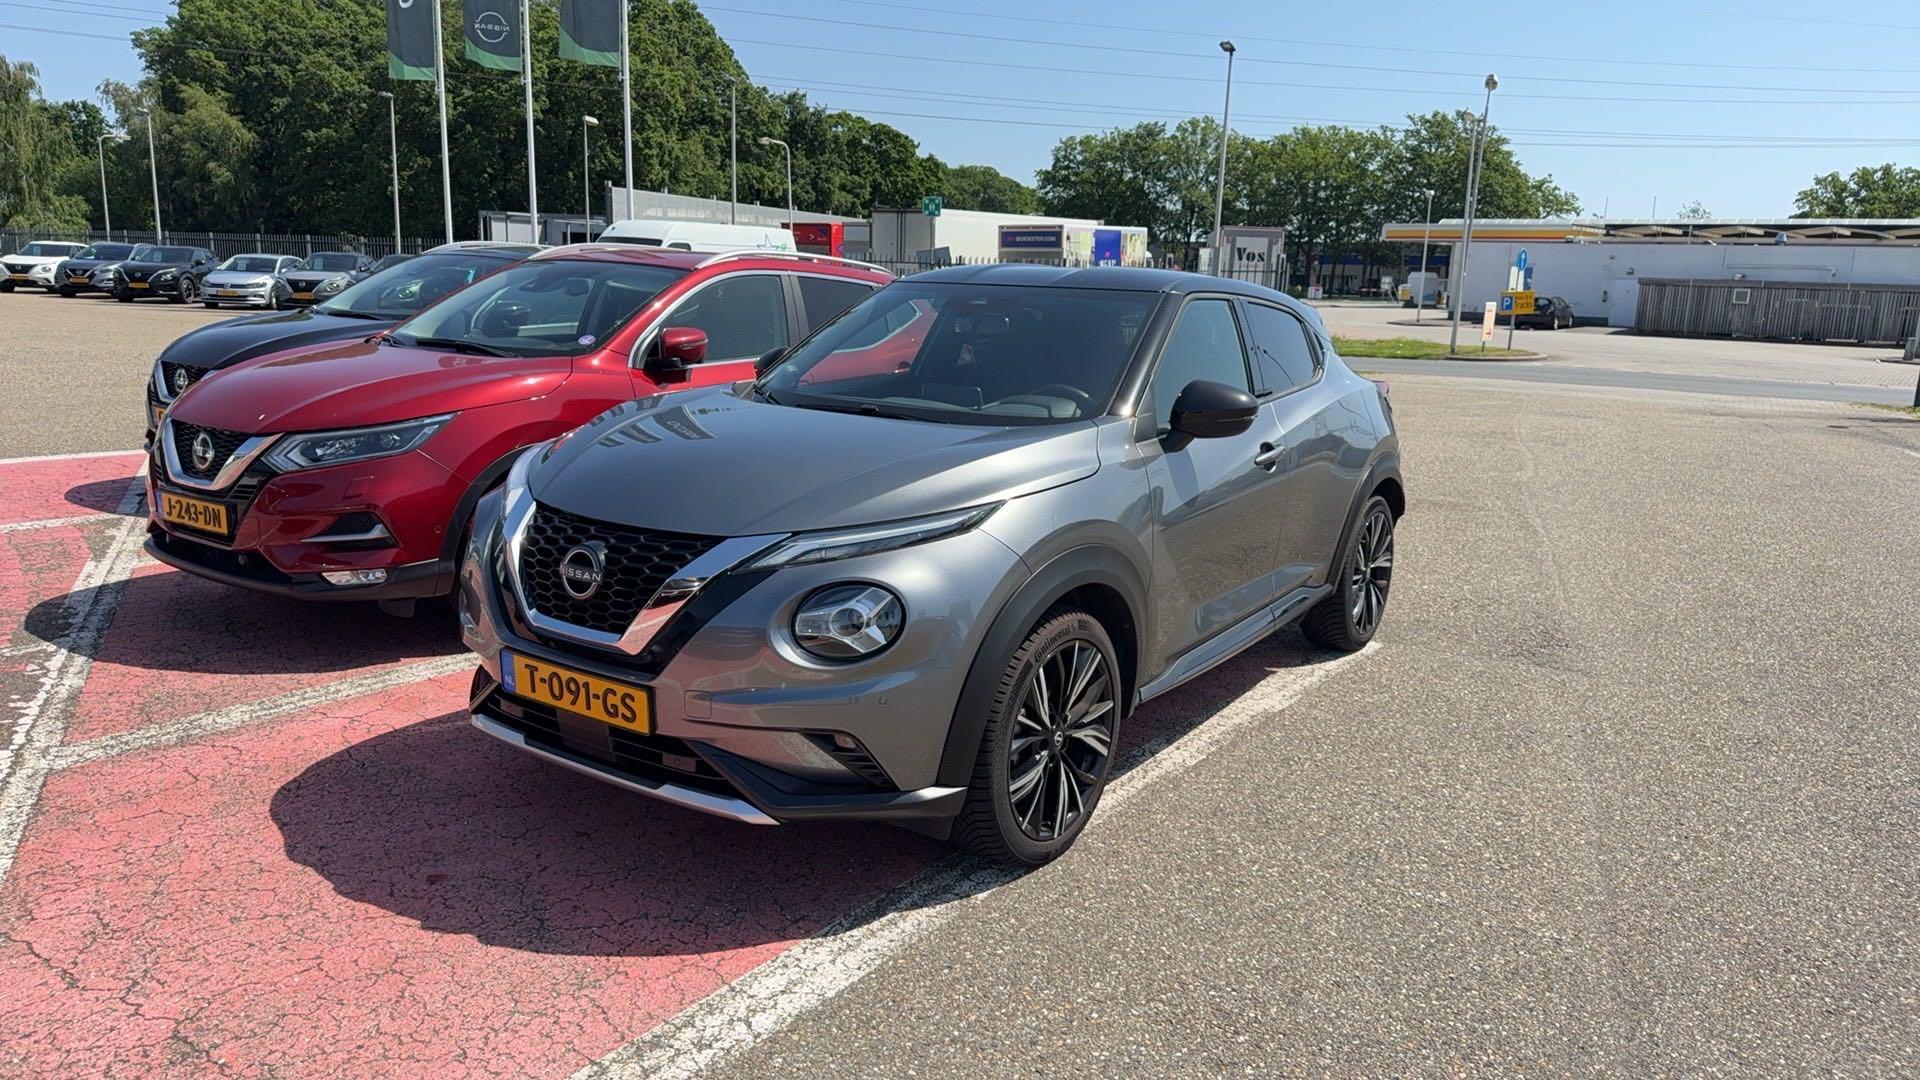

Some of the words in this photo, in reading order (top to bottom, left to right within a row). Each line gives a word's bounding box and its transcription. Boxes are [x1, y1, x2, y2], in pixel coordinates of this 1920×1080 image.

[1236, 247, 1266, 263] Vos
[1503, 297, 1511, 309] P
[166, 497, 222, 529] J-243-DN
[559, 562, 601, 583] NISSAN
[1034, 623, 1071, 663] Continental
[524, 663, 637, 724] T-091-GS
